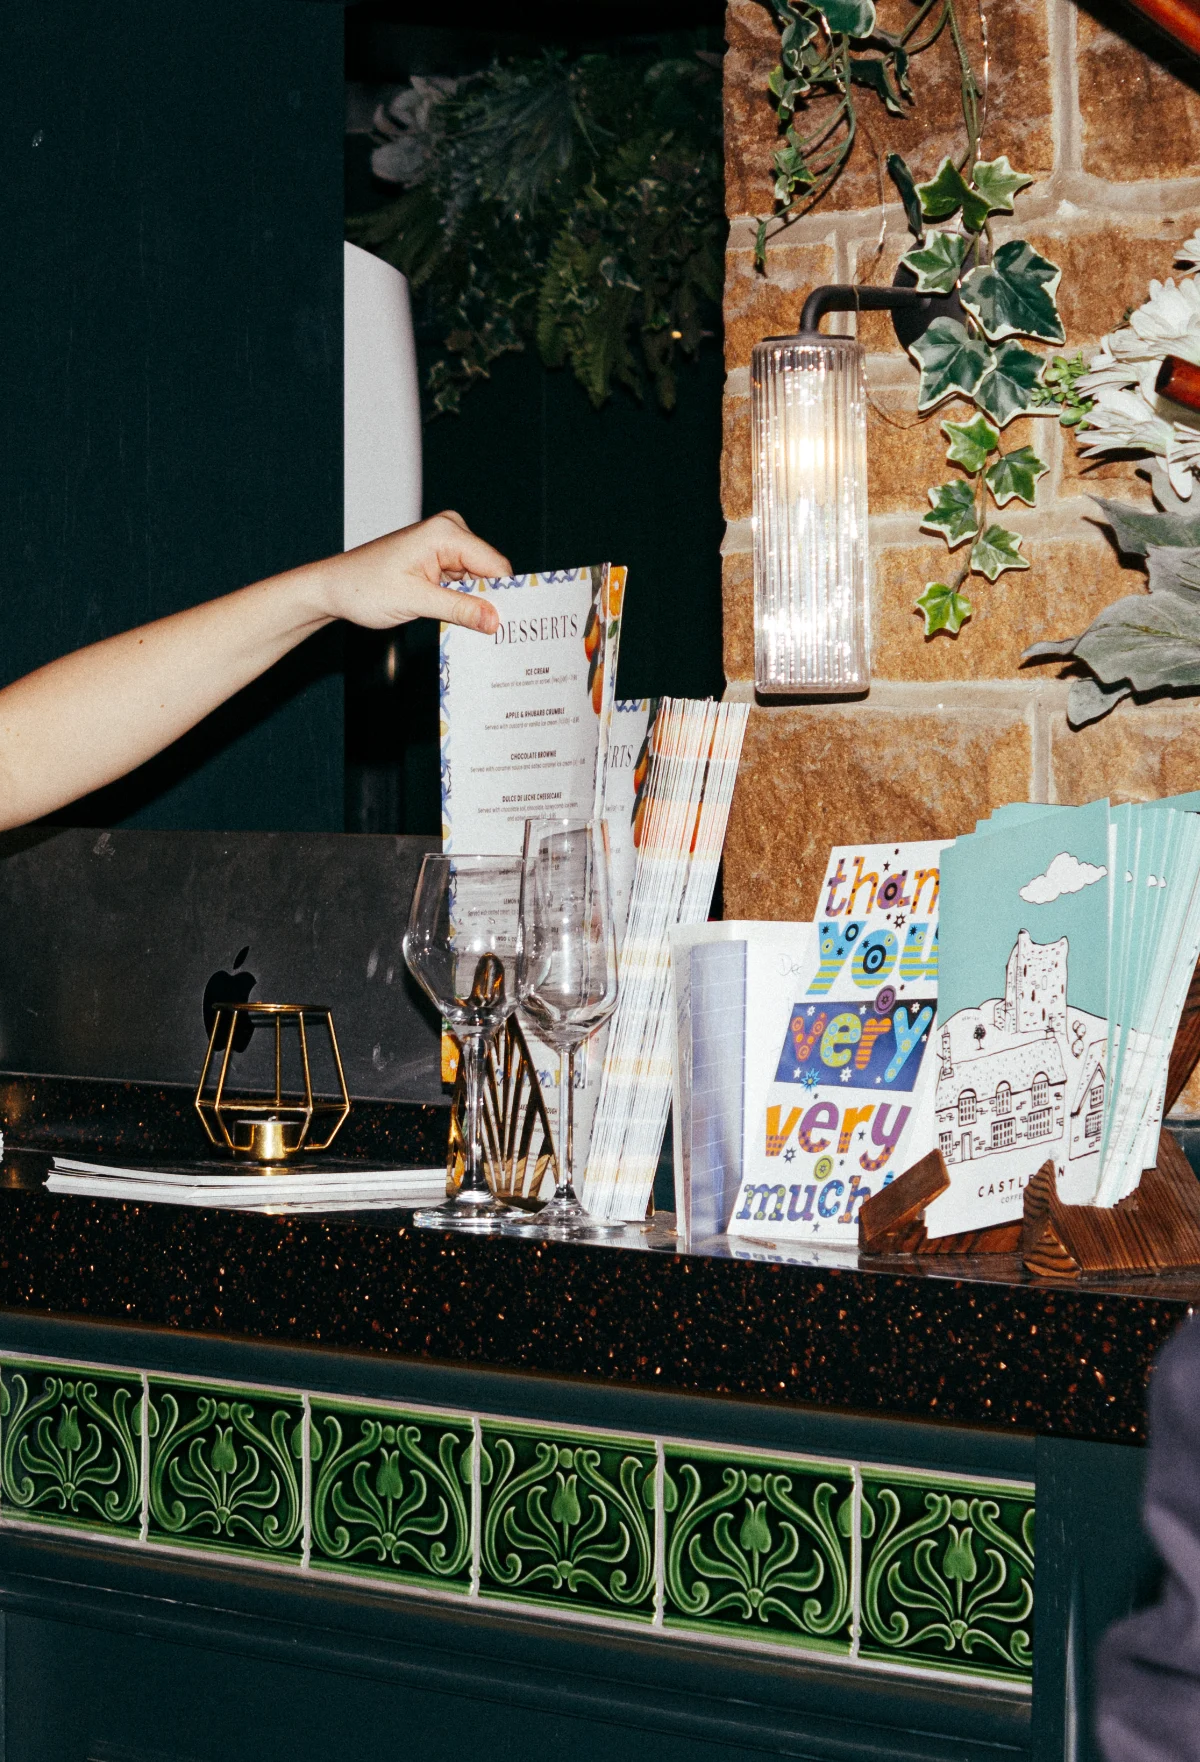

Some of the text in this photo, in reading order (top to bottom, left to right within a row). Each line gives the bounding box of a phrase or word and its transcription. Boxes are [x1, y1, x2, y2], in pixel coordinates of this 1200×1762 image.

[495, 613, 579, 645] DESSERTS
[533, 667, 550, 675] CREAM
[505, 711, 519, 719] APPLE
[525, 709, 545, 717] RHUBARB
[546, 707, 565, 716] CRUMBLE
[511, 750, 556, 760] CHOCOLATE BROWNIE
[502, 795, 516, 803] DULCE
[537, 792, 562, 800] CHEESECAKE
[825, 856, 940, 917] than
[806, 922, 939, 995] you
[791, 1006, 932, 1083] very
[766, 1101, 912, 1171] very
[978, 1165, 1065, 1198] CASTLN
[1000, 1193, 1024, 1204] COFFE
